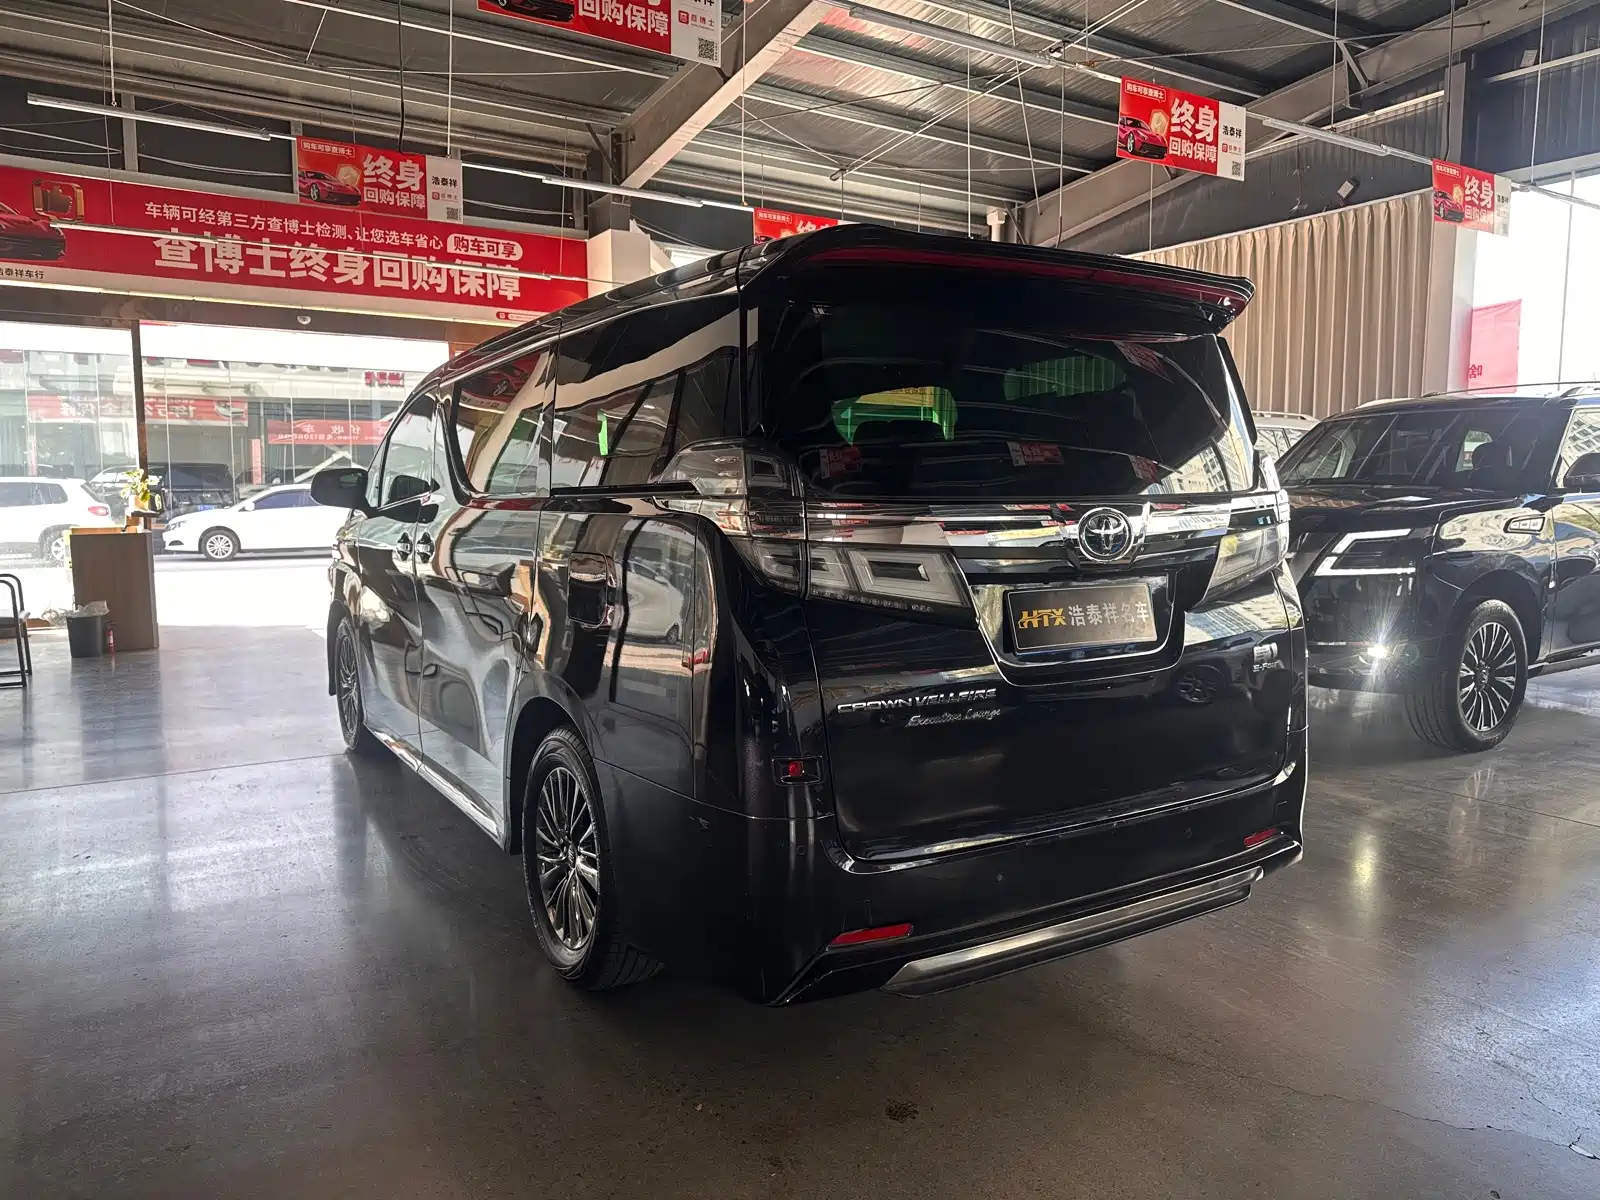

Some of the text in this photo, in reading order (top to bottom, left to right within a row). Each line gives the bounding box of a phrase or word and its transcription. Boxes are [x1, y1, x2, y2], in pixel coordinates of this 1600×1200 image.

[578, 0, 669, 36] 回购保障
[1170, 98, 1217, 142] 终身
[303, 141, 352, 156] 购车可享查博士
[1168, 136, 1217, 163] 回购保障
[362, 153, 425, 192] 终身
[431, 175, 458, 189] 浩泰祥
[363, 187, 426, 210] 回购保障
[1464, 174, 1494, 209] 终身
[453, 235, 517, 258] 购车可享
[153, 227, 521, 301] 查博士终身回购保障
[1017, 607, 1067, 629] HTX
[1068, 601, 1150, 627] 浩泰祥名车
[837, 688, 997, 714] CROWN VELLFIRE
